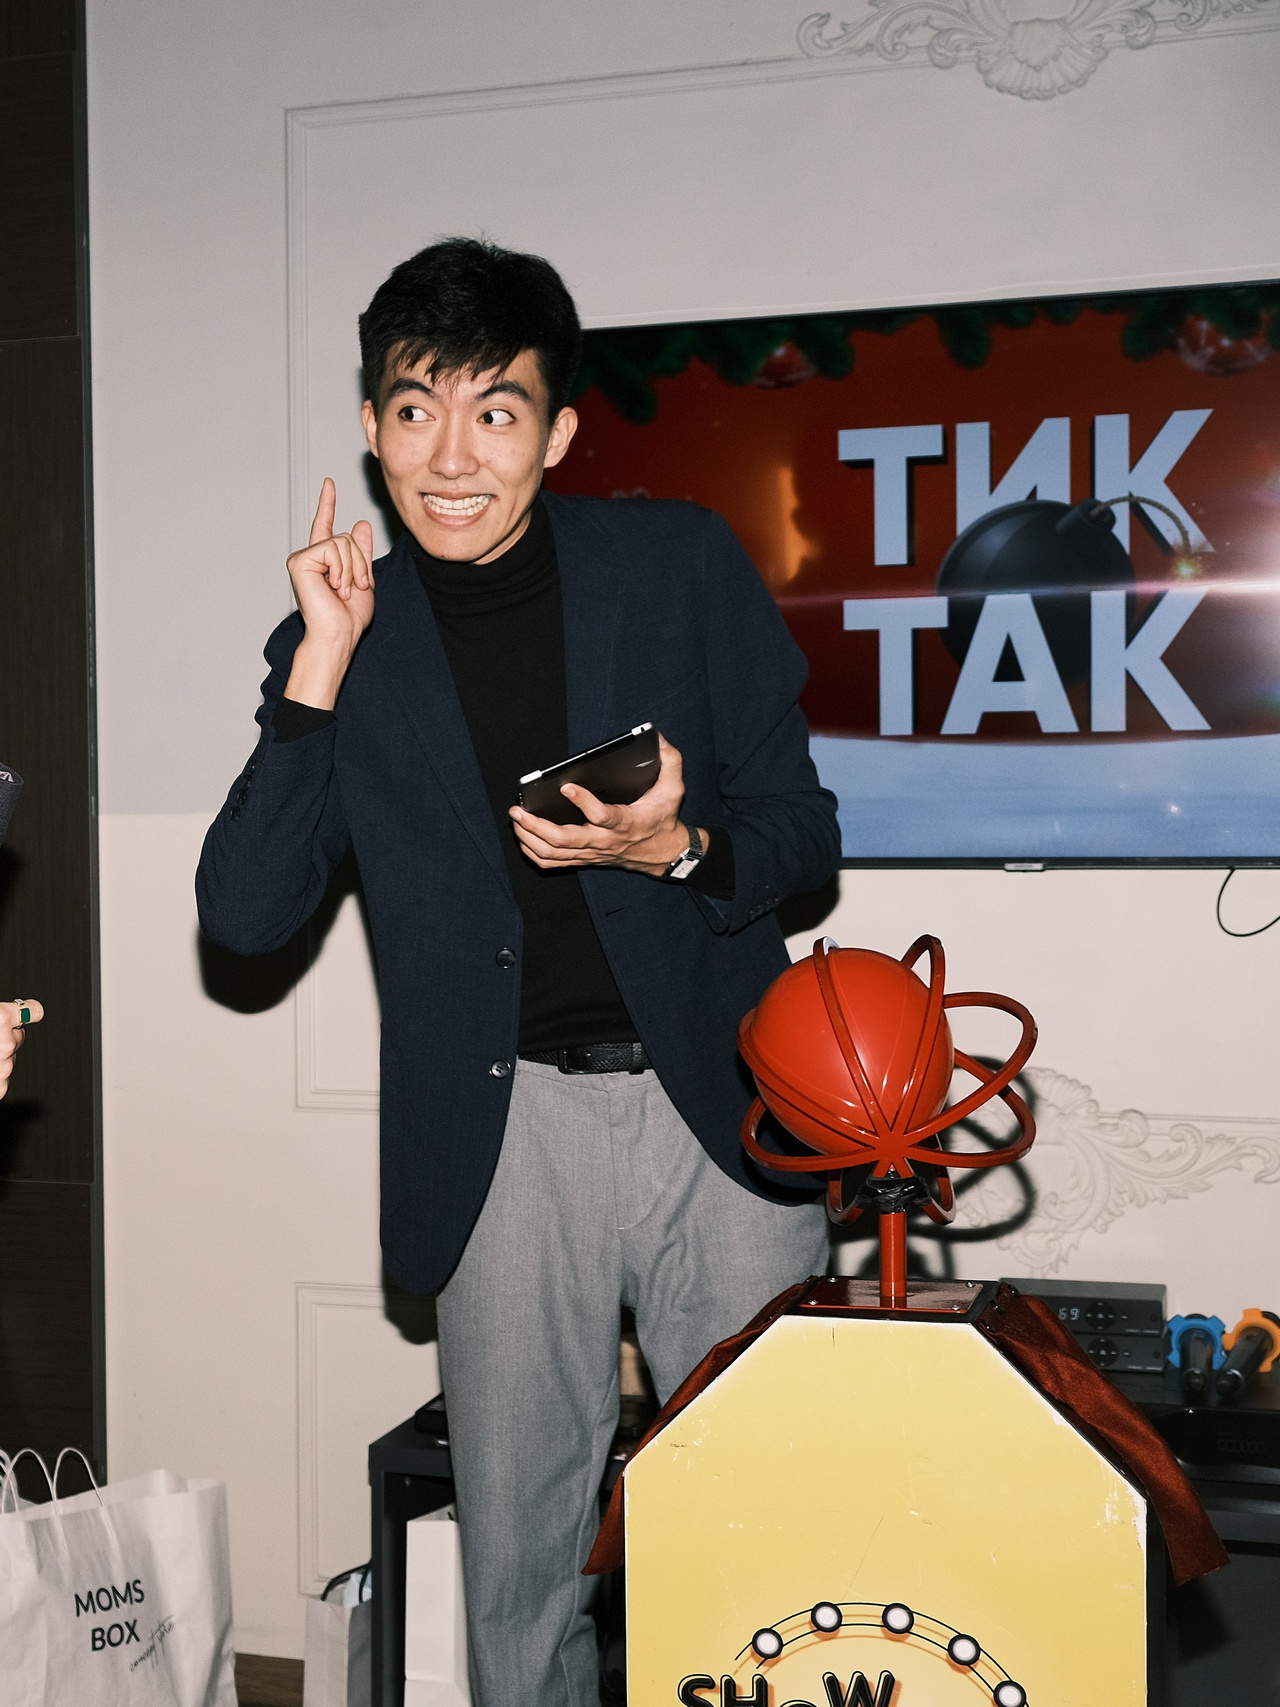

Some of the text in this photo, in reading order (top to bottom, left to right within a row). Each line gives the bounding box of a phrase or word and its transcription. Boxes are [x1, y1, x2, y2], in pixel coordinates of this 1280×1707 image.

[838, 409, 1214, 566] ТИК
[843, 588, 1213, 737] ТАК
[74, 1579, 145, 1617] MOMS
[91, 1619, 141, 1652] BOX
[678, 1670, 896, 1707] SHW
